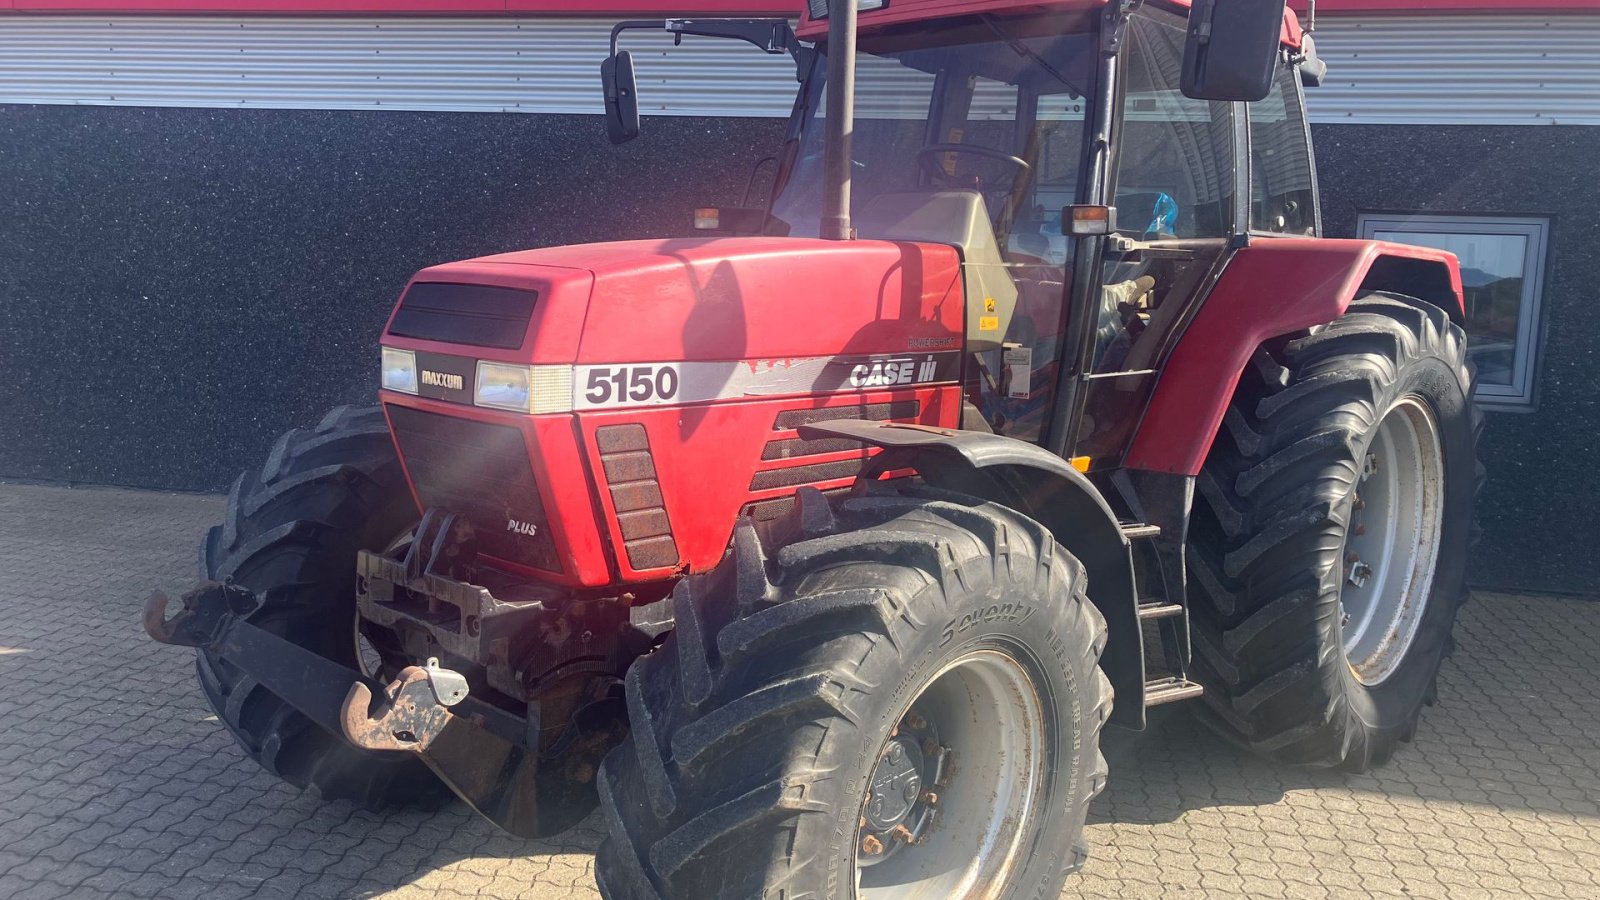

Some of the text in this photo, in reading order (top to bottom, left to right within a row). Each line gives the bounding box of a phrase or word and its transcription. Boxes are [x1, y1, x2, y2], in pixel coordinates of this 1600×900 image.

[422, 370, 463, 391] MAXXUM
[585, 366, 679, 404] 5150
[850, 363, 915, 387] CASE
[507, 519, 537, 537] PLUS
[938, 599, 1039, 649] Seventy
